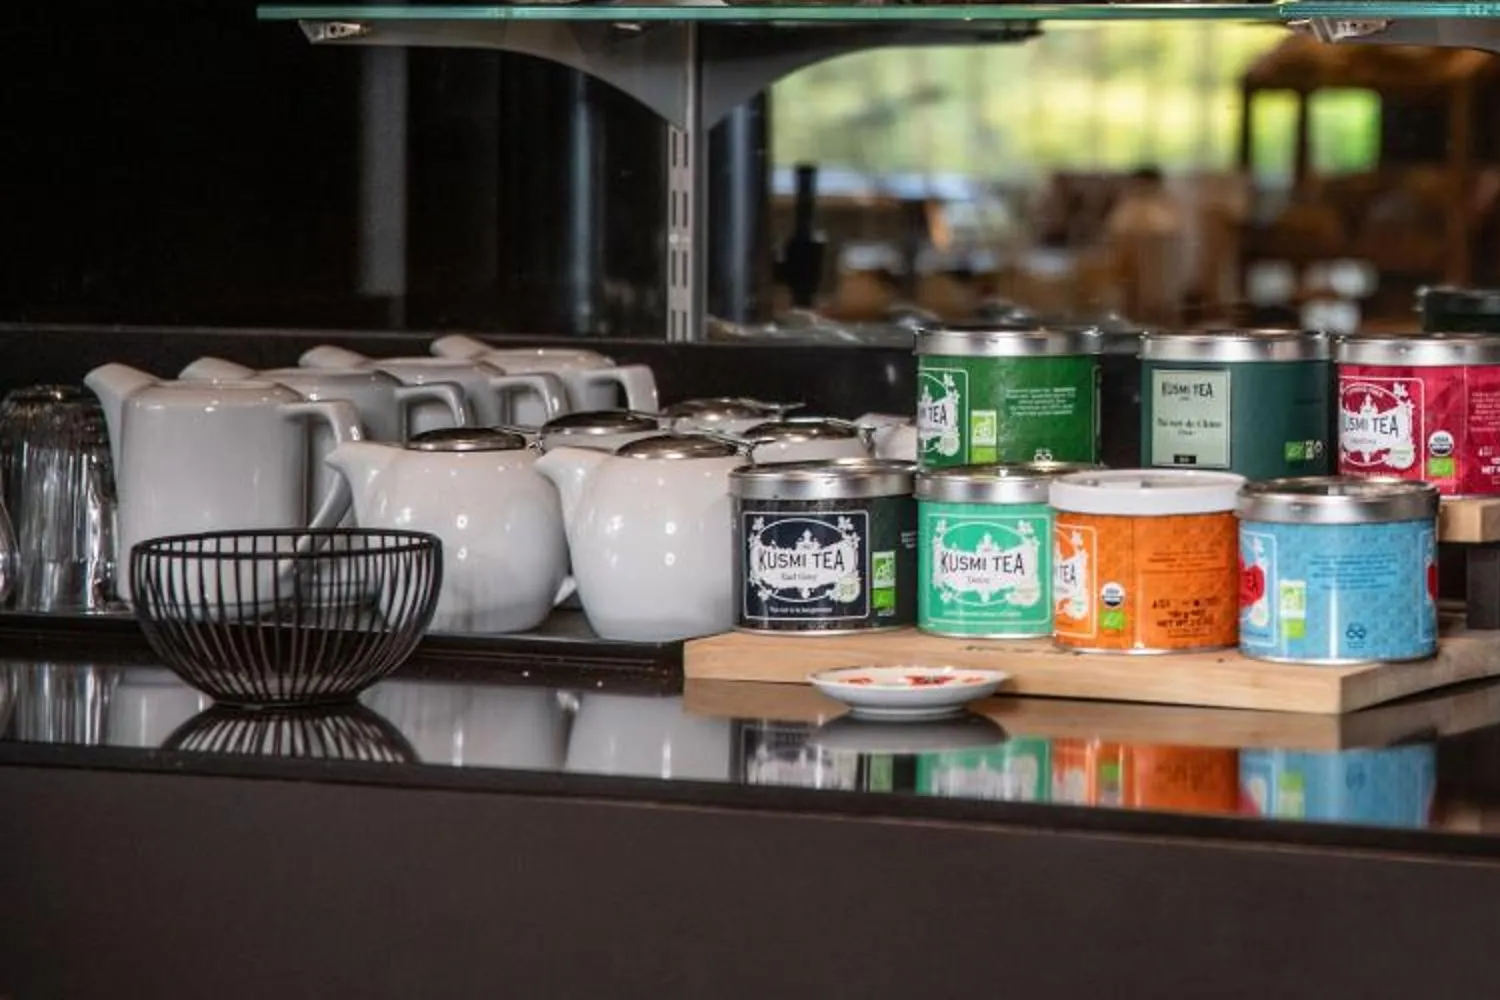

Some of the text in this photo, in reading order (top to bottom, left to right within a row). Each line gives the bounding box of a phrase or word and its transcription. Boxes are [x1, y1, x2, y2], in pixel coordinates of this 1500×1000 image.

[1193, 381, 1214, 399] TEA
[927, 405, 949, 426] TEA
[1371, 415, 1399, 438] TEA
[758, 549, 846, 573] KUSMI TEA
[940, 551, 1025, 576] KUSMI TEA
